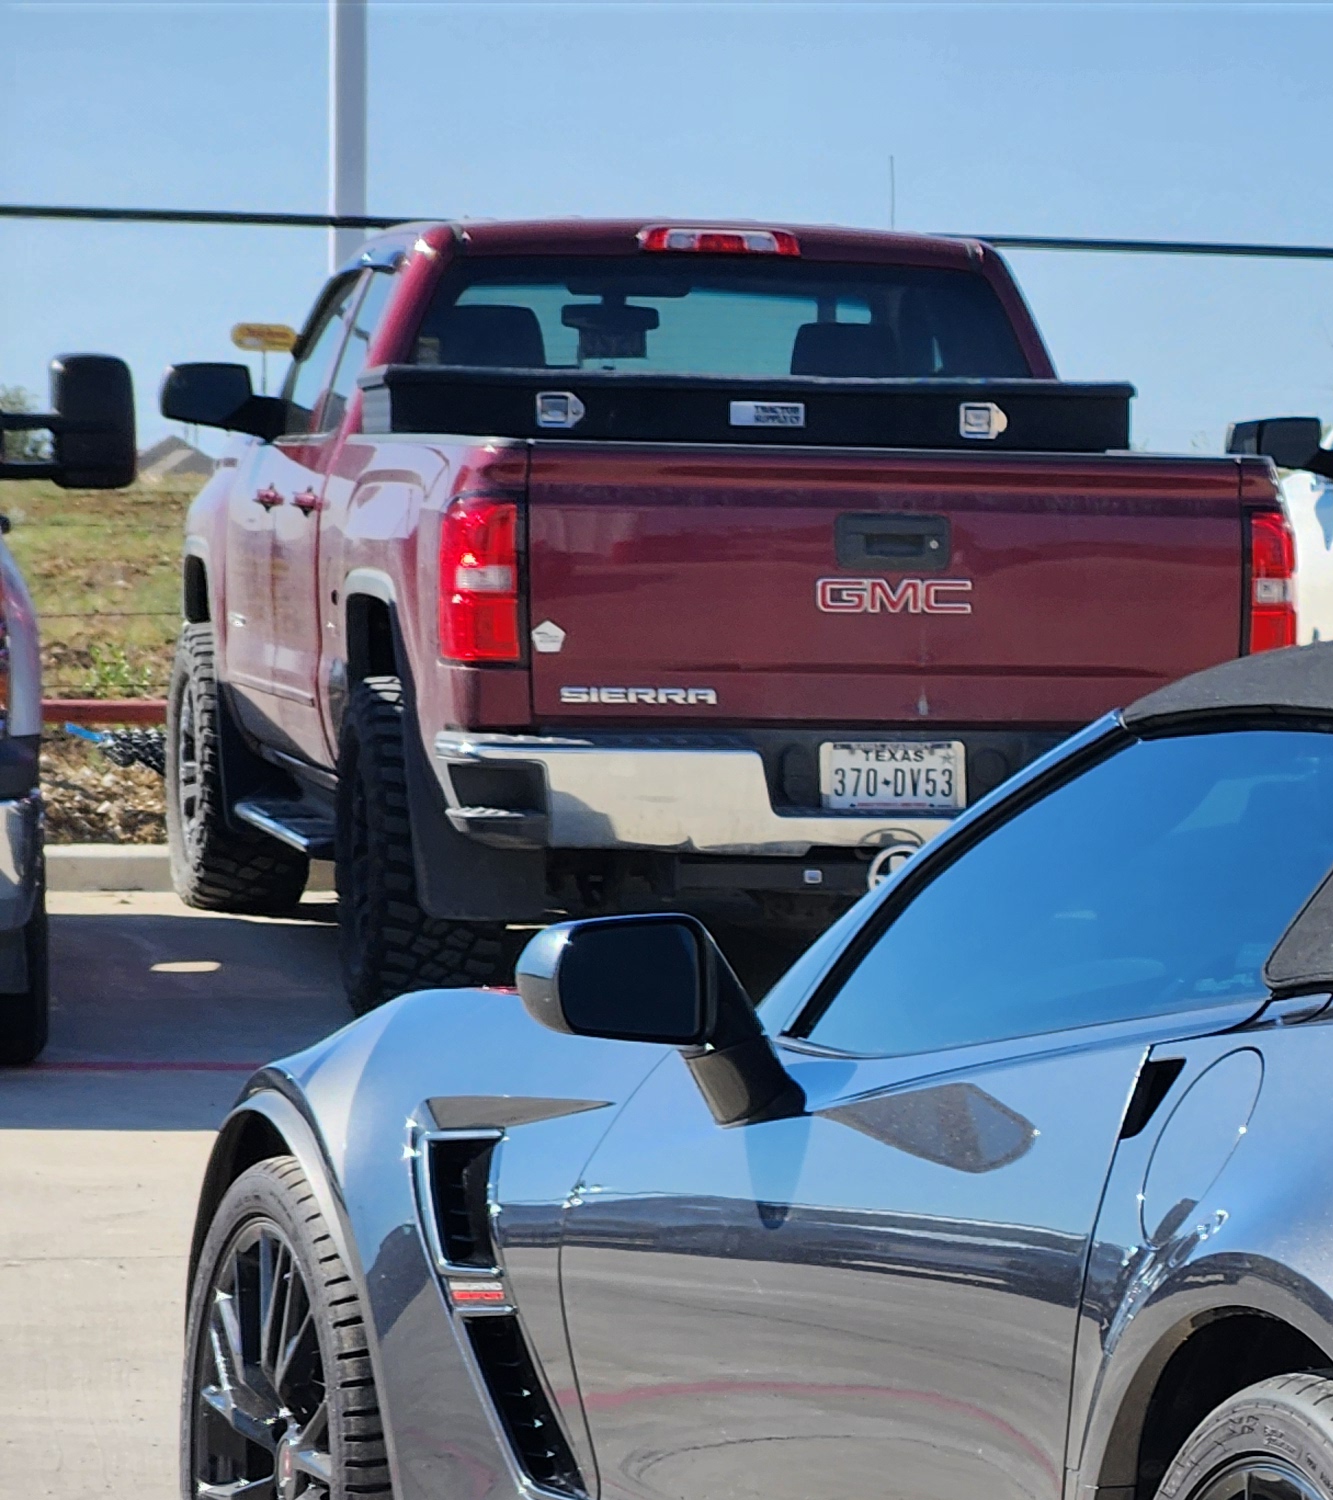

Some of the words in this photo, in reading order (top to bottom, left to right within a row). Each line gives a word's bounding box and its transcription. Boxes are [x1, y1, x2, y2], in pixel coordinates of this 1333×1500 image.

[816, 578, 973, 614] GMC
[560, 686, 718, 705] SIERRA
[862, 750, 925, 763] TEXAS
